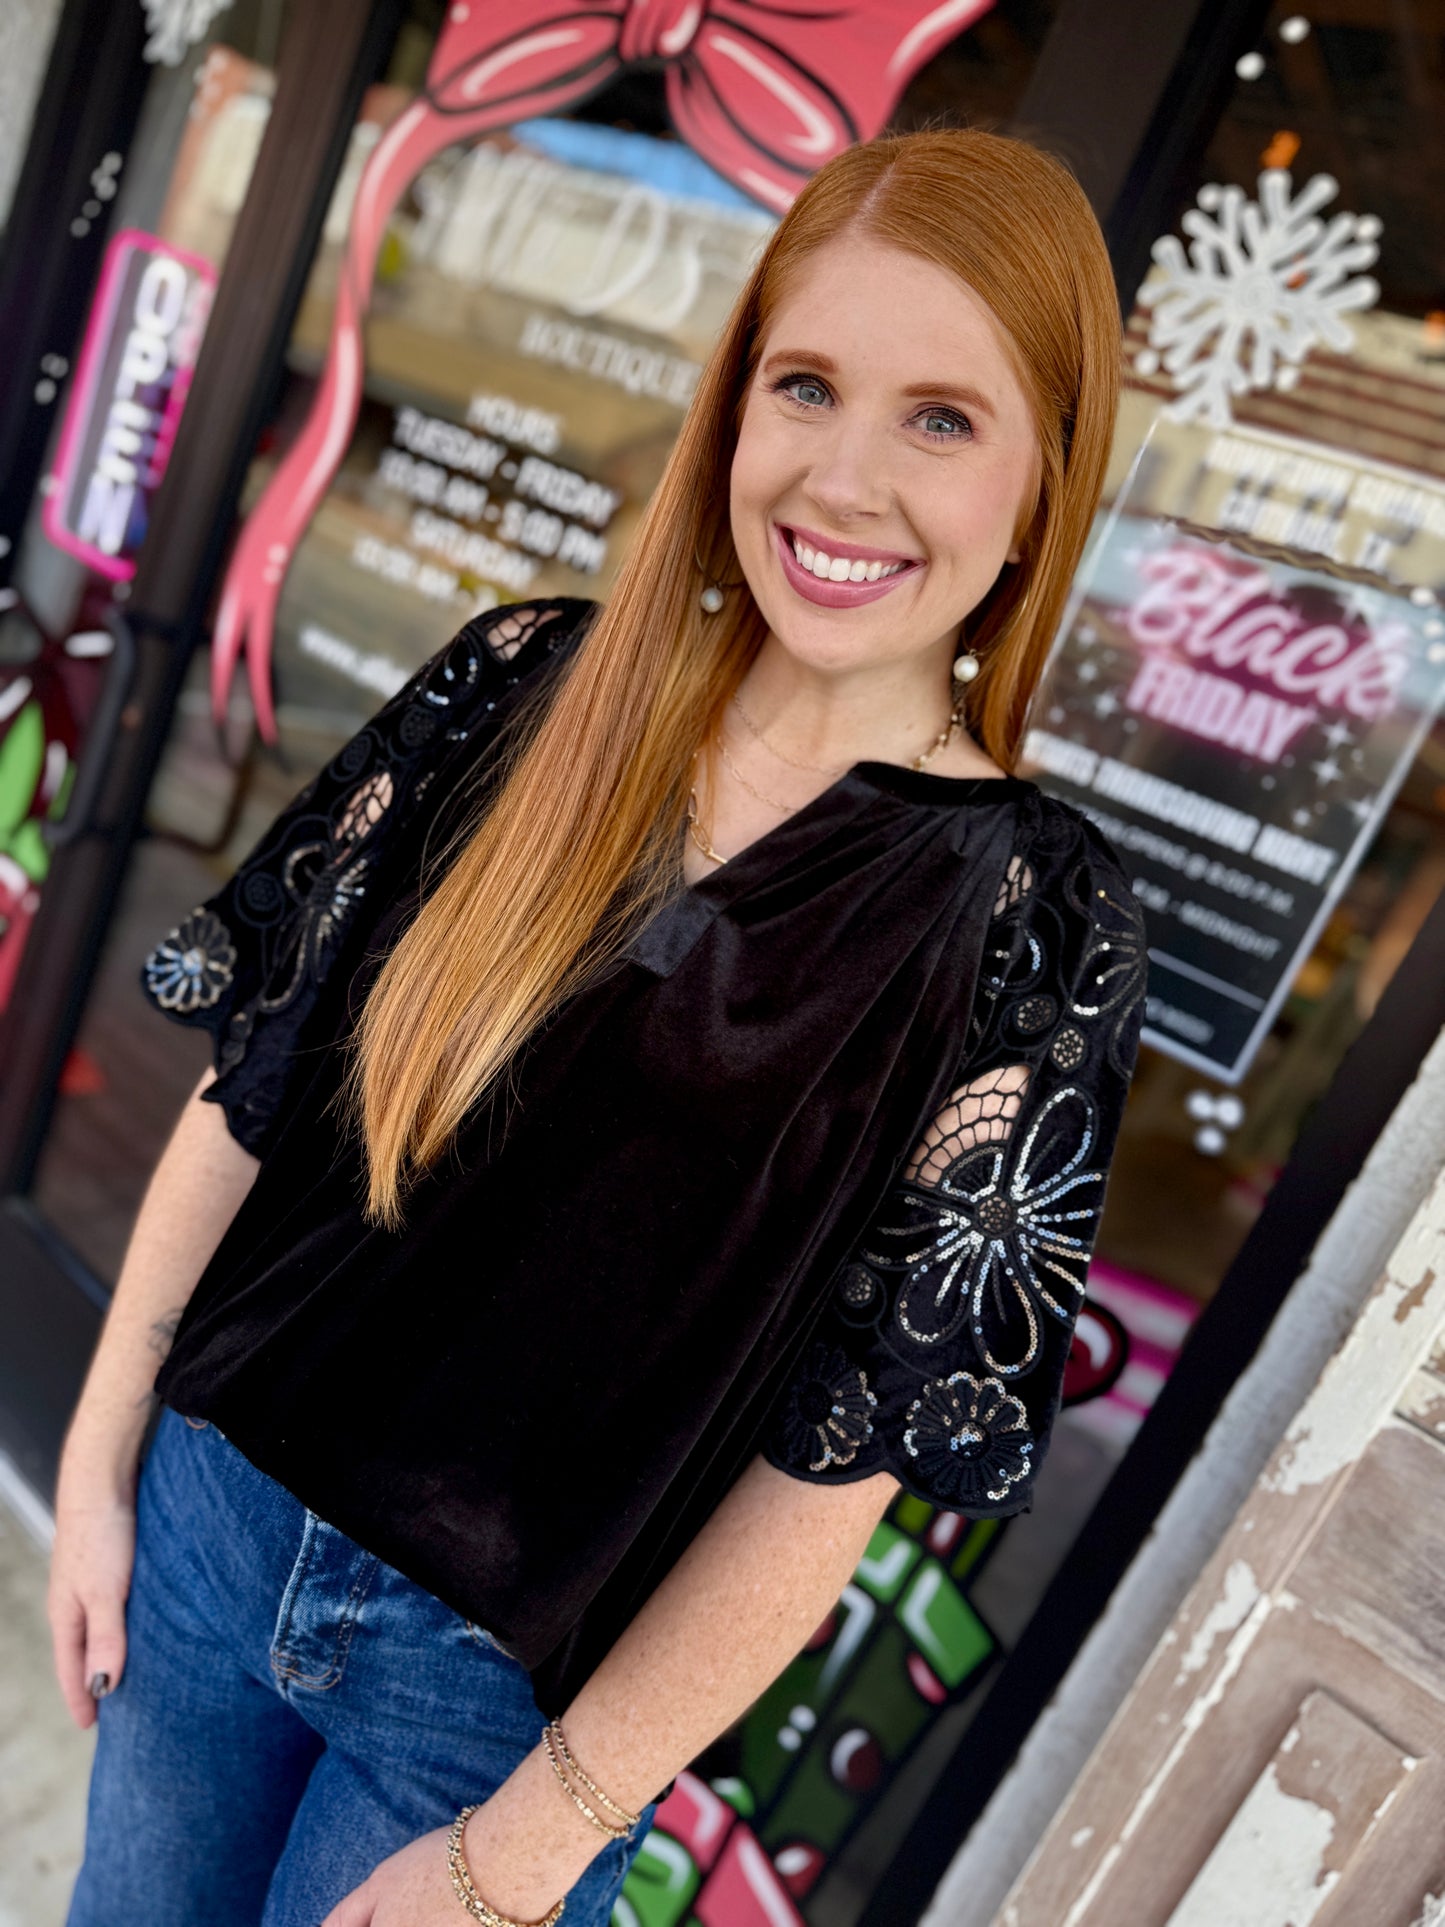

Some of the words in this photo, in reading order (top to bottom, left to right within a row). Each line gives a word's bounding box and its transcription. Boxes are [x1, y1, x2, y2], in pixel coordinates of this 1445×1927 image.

[80, 256, 186, 555] OPEN
[519, 315, 702, 404] BOUTIQUE
[394, 408, 506, 480] TUESDAY
[515, 456, 620, 529] FRIDAY
[467, 396, 562, 455] HOURS
[411, 508, 542, 594] SATURDAY
[443, 476, 489, 523] AM
[498, 501, 564, 557] 5:00
[556, 523, 608, 575] PM
[1129, 544, 1412, 722] Black
[1126, 655, 1318, 763] FRIDAY
[1092, 757, 1261, 854] THANKSGIVING
[1251, 823, 1337, 886] NIGHT
[1125, 824, 1188, 871] OPENS
[1179, 902, 1281, 960] MIDNIGHT
